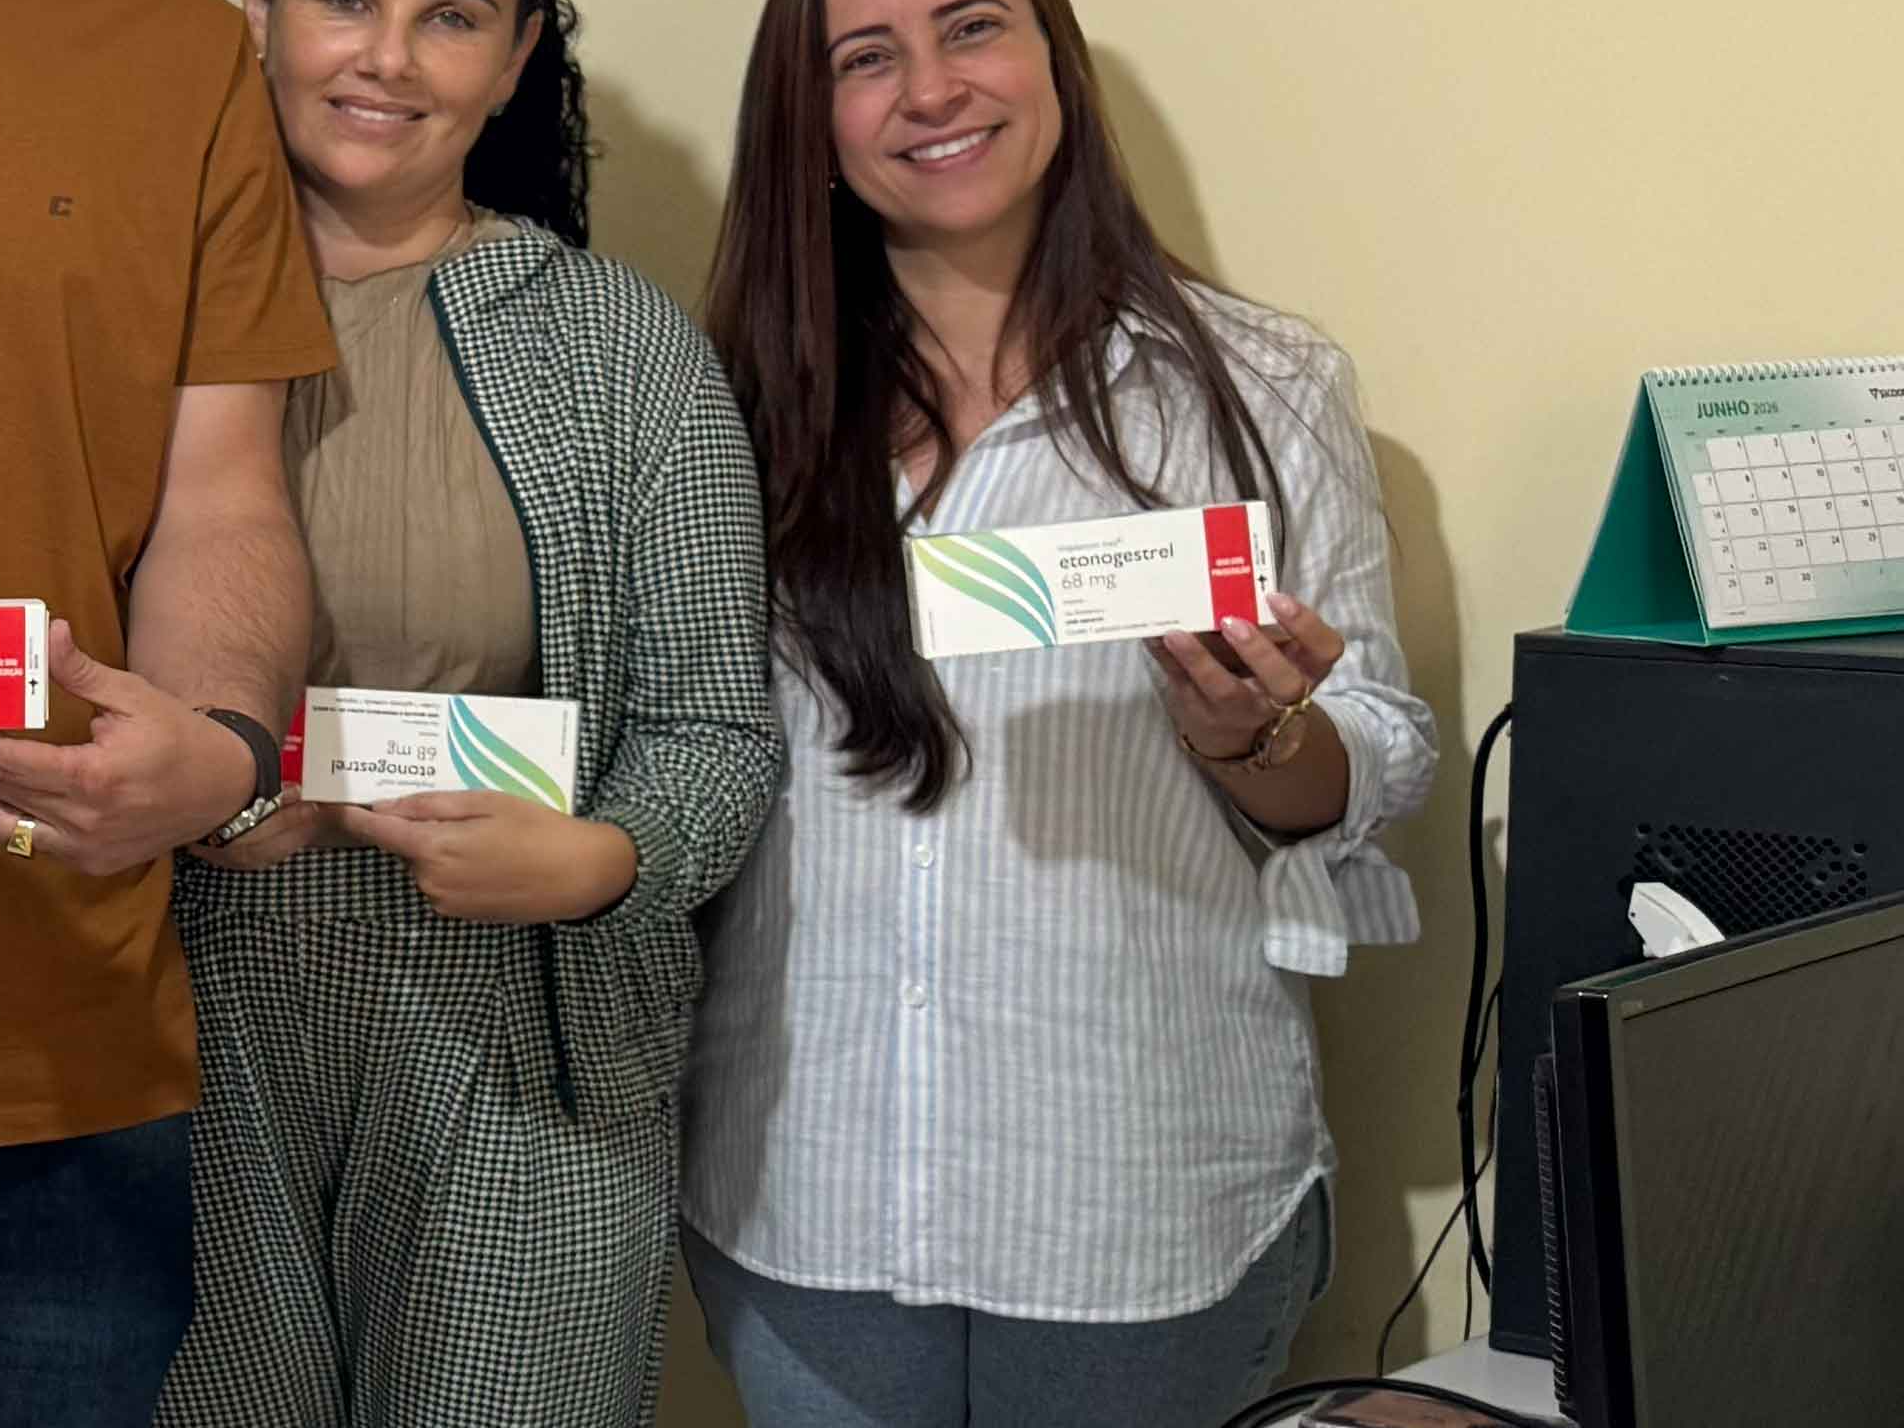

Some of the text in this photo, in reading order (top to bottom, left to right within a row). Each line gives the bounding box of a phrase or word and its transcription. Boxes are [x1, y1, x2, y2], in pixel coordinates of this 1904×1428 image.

[1697, 400, 1750, 419] JUNHO
[1059, 543, 1174, 569] etonogestrel
[1061, 572, 1117, 589] 68 mg
[331, 759, 436, 778] etonogestrel
